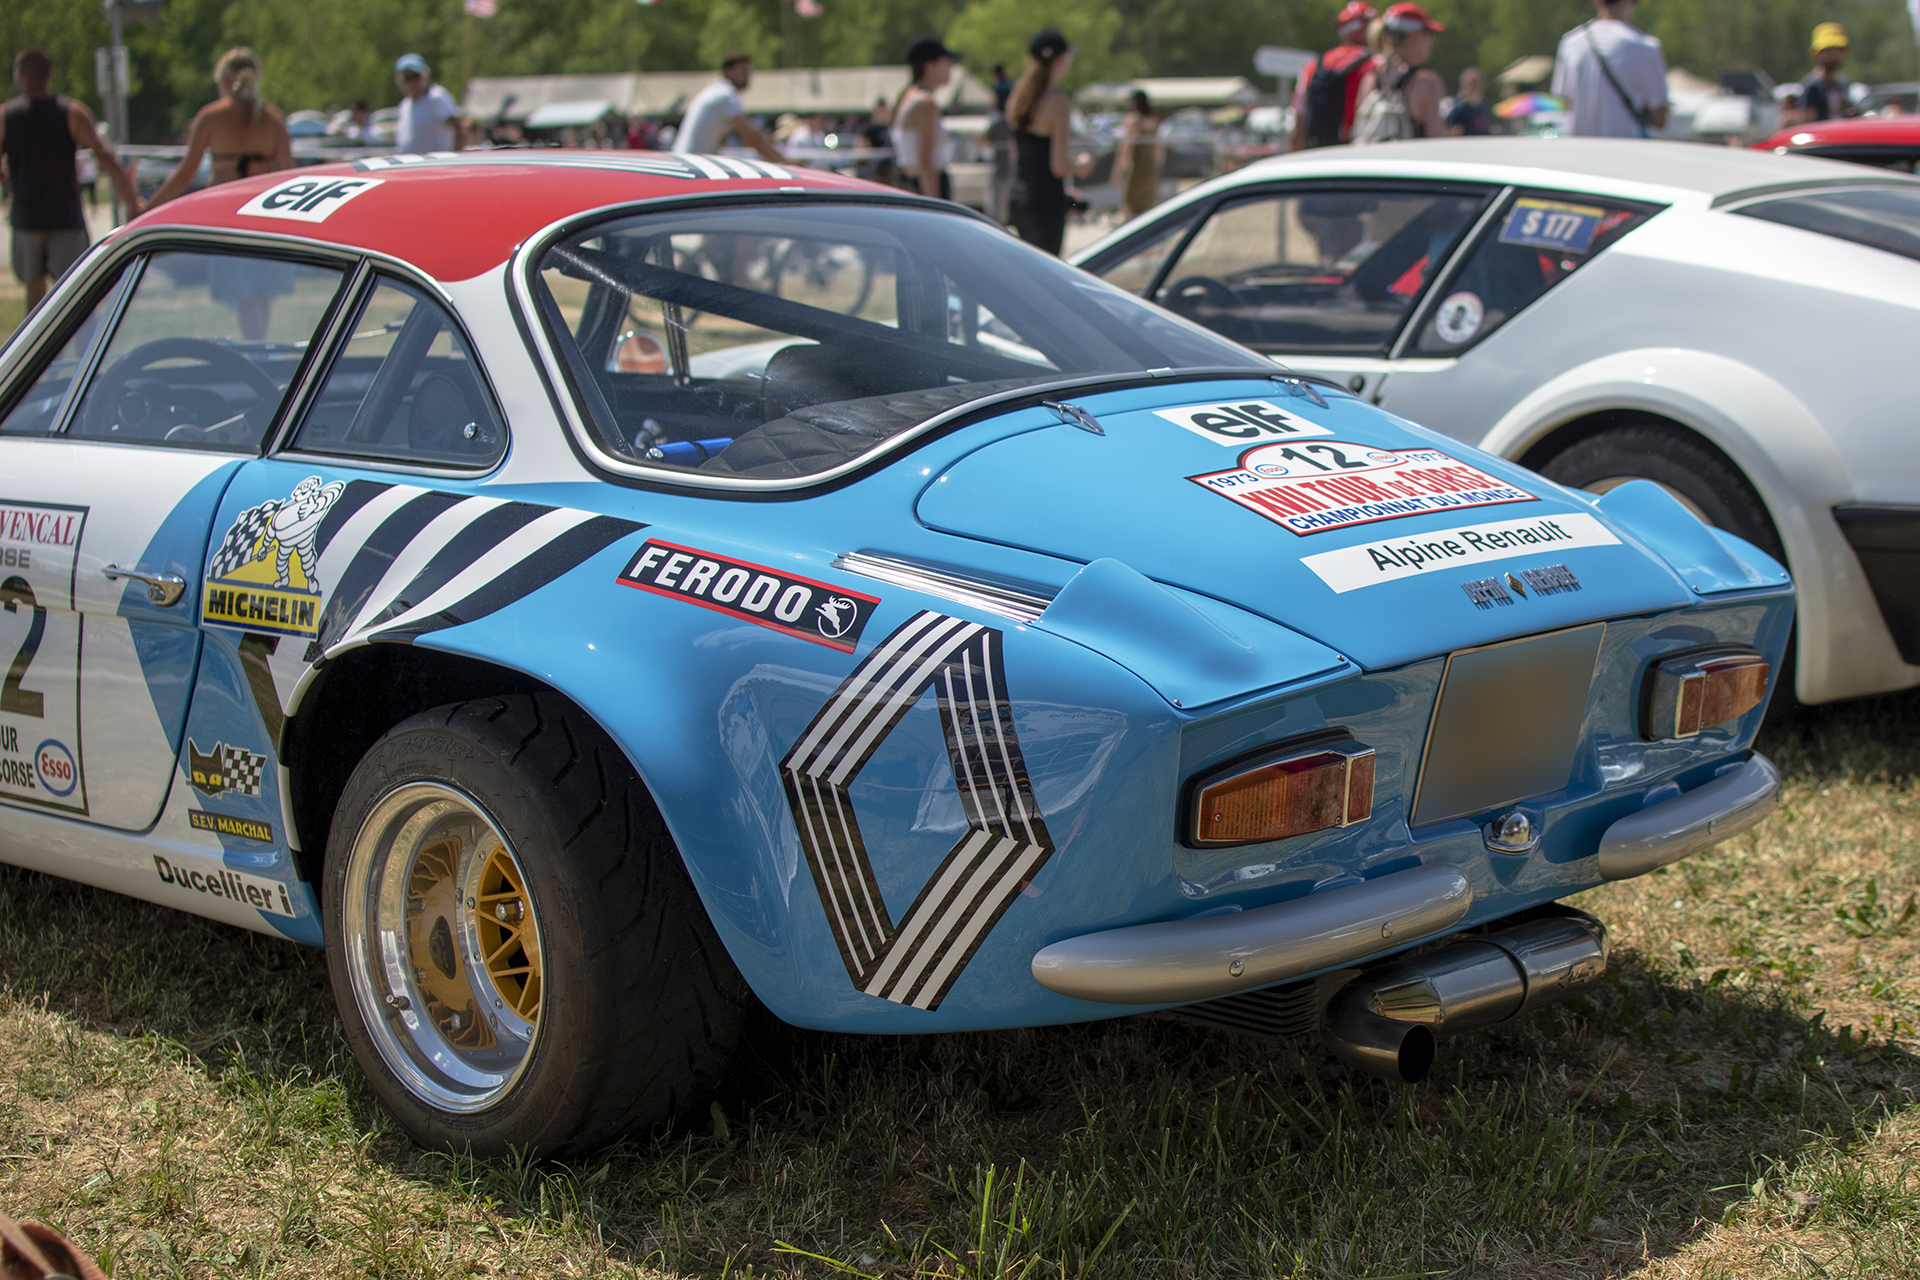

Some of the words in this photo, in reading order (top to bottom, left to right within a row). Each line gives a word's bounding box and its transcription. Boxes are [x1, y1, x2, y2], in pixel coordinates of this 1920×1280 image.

[261, 179, 369, 213] elf
[1520, 210, 1544, 236] S
[1543, 213, 1584, 241] 177
[1190, 404, 1301, 438] elf
[1280, 445, 1371, 471] 12
[1405, 452, 1450, 462] 1973
[1207, 473, 1259, 489] 1973
[1295, 476, 1402, 507] TOUR
[1383, 480, 1427, 497] DE
[1394, 466, 1504, 494] CORSE
[1237, 485, 1332, 518] XVII
[1288, 498, 1431, 529] CHAMPIONNAT
[1427, 494, 1461, 507] DU
[1456, 488, 1526, 503] MONDE
[0, 547, 31, 569] SE
[1366, 539, 1466, 572] Alpine
[1458, 520, 1573, 552] Renault
[629, 546, 812, 623] FERODO
[208, 588, 315, 627] MICHELIN
[388, 733, 474, 761] R888
[0, 757, 36, 789] ORSE
[191, 813, 217, 830] S.E.V.
[217, 817, 272, 841] MARCHAL
[153, 854, 273, 911] Ducellier
